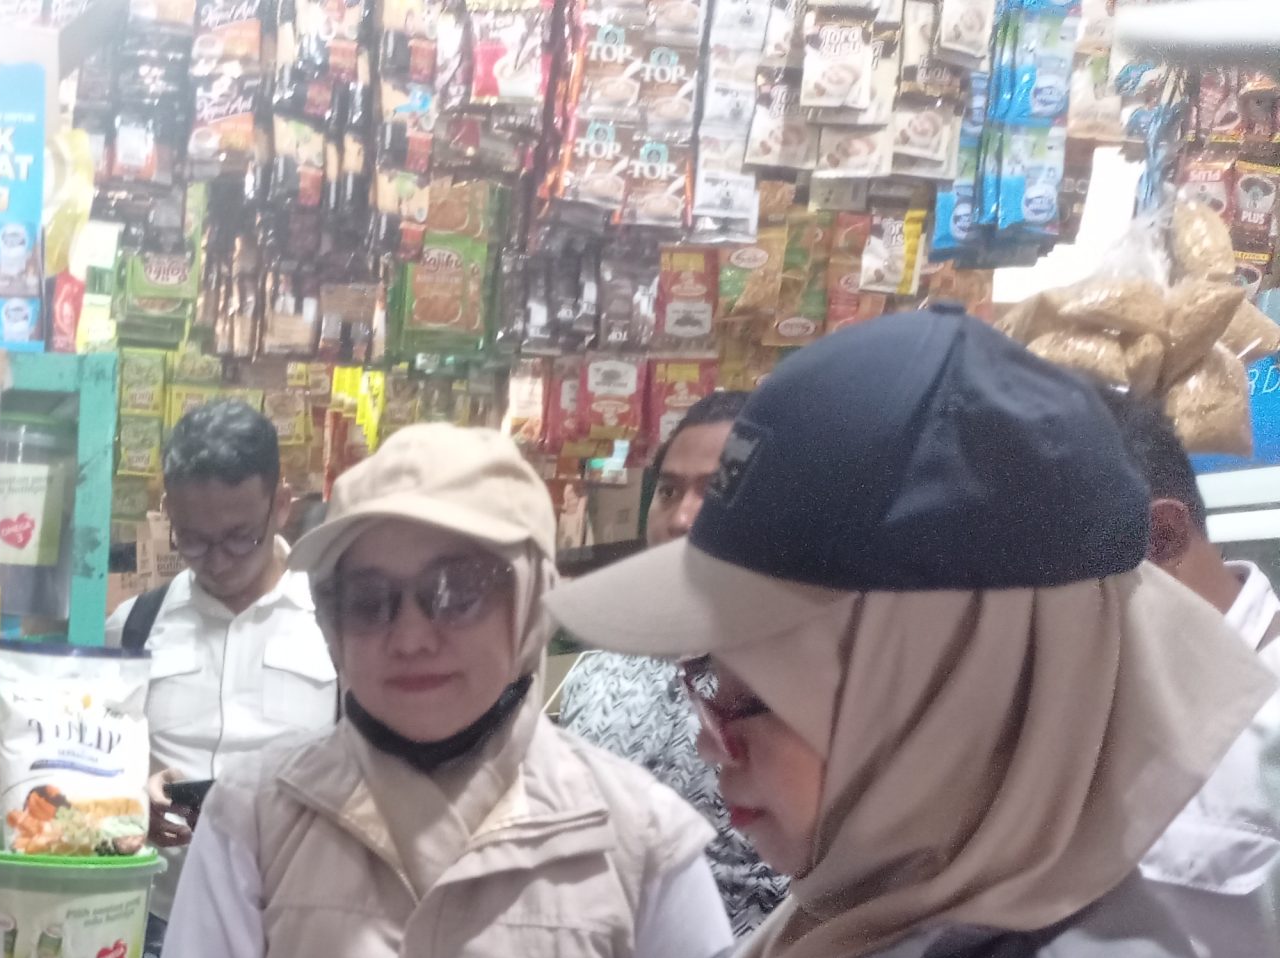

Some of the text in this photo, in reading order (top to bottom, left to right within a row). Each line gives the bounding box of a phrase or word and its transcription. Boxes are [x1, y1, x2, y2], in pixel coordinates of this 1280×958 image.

[587, 42, 632, 62] TOP
[641, 64, 687, 83] TOP
[575, 140, 622, 160] TOP
[630, 161, 677, 180] TOP
[1241, 211, 1265, 224] PLUS
